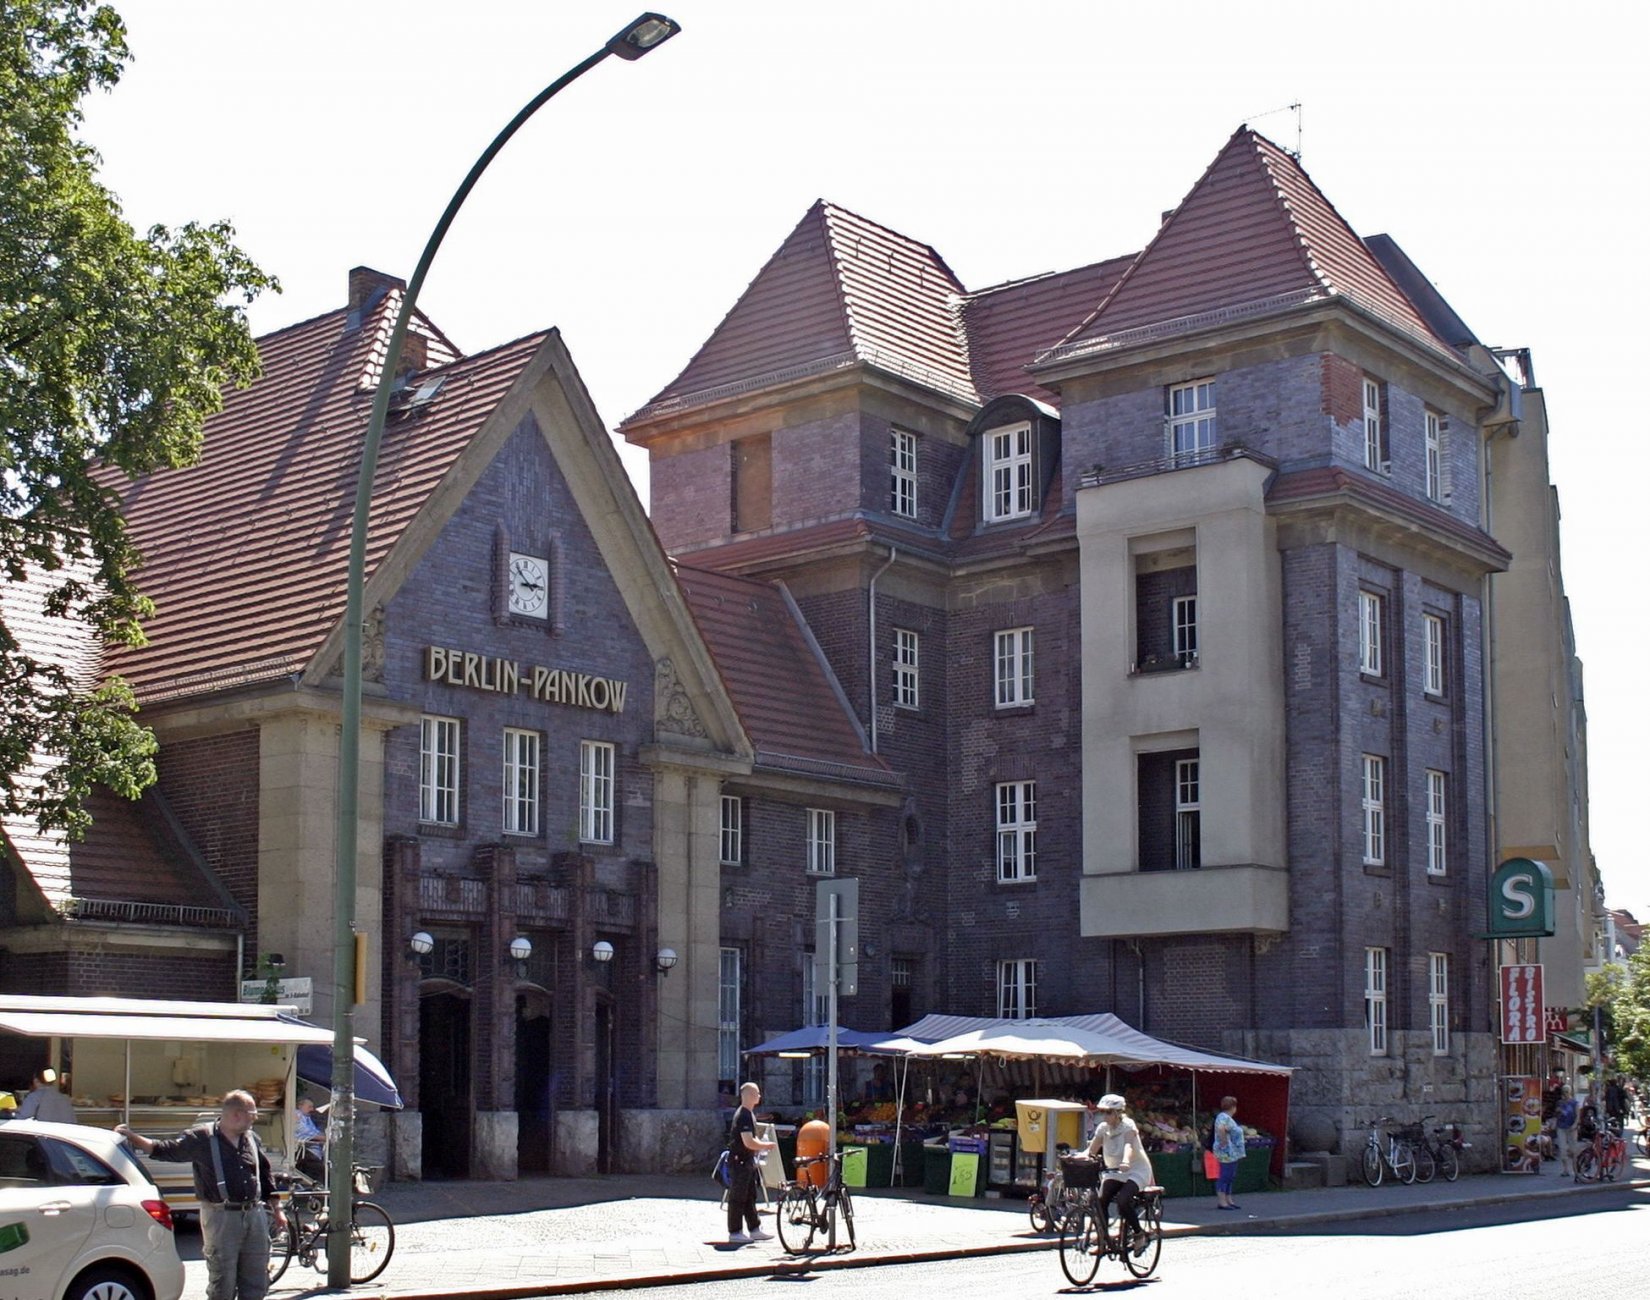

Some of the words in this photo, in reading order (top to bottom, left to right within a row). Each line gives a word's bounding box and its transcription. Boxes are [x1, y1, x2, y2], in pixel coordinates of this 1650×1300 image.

[429, 645, 628, 714] BERLIN-PANKOW
[1502, 874, 1534, 919] S
[1508, 966, 1521, 1042] FLORA
[1525, 966, 1537, 1042] BISTRO
